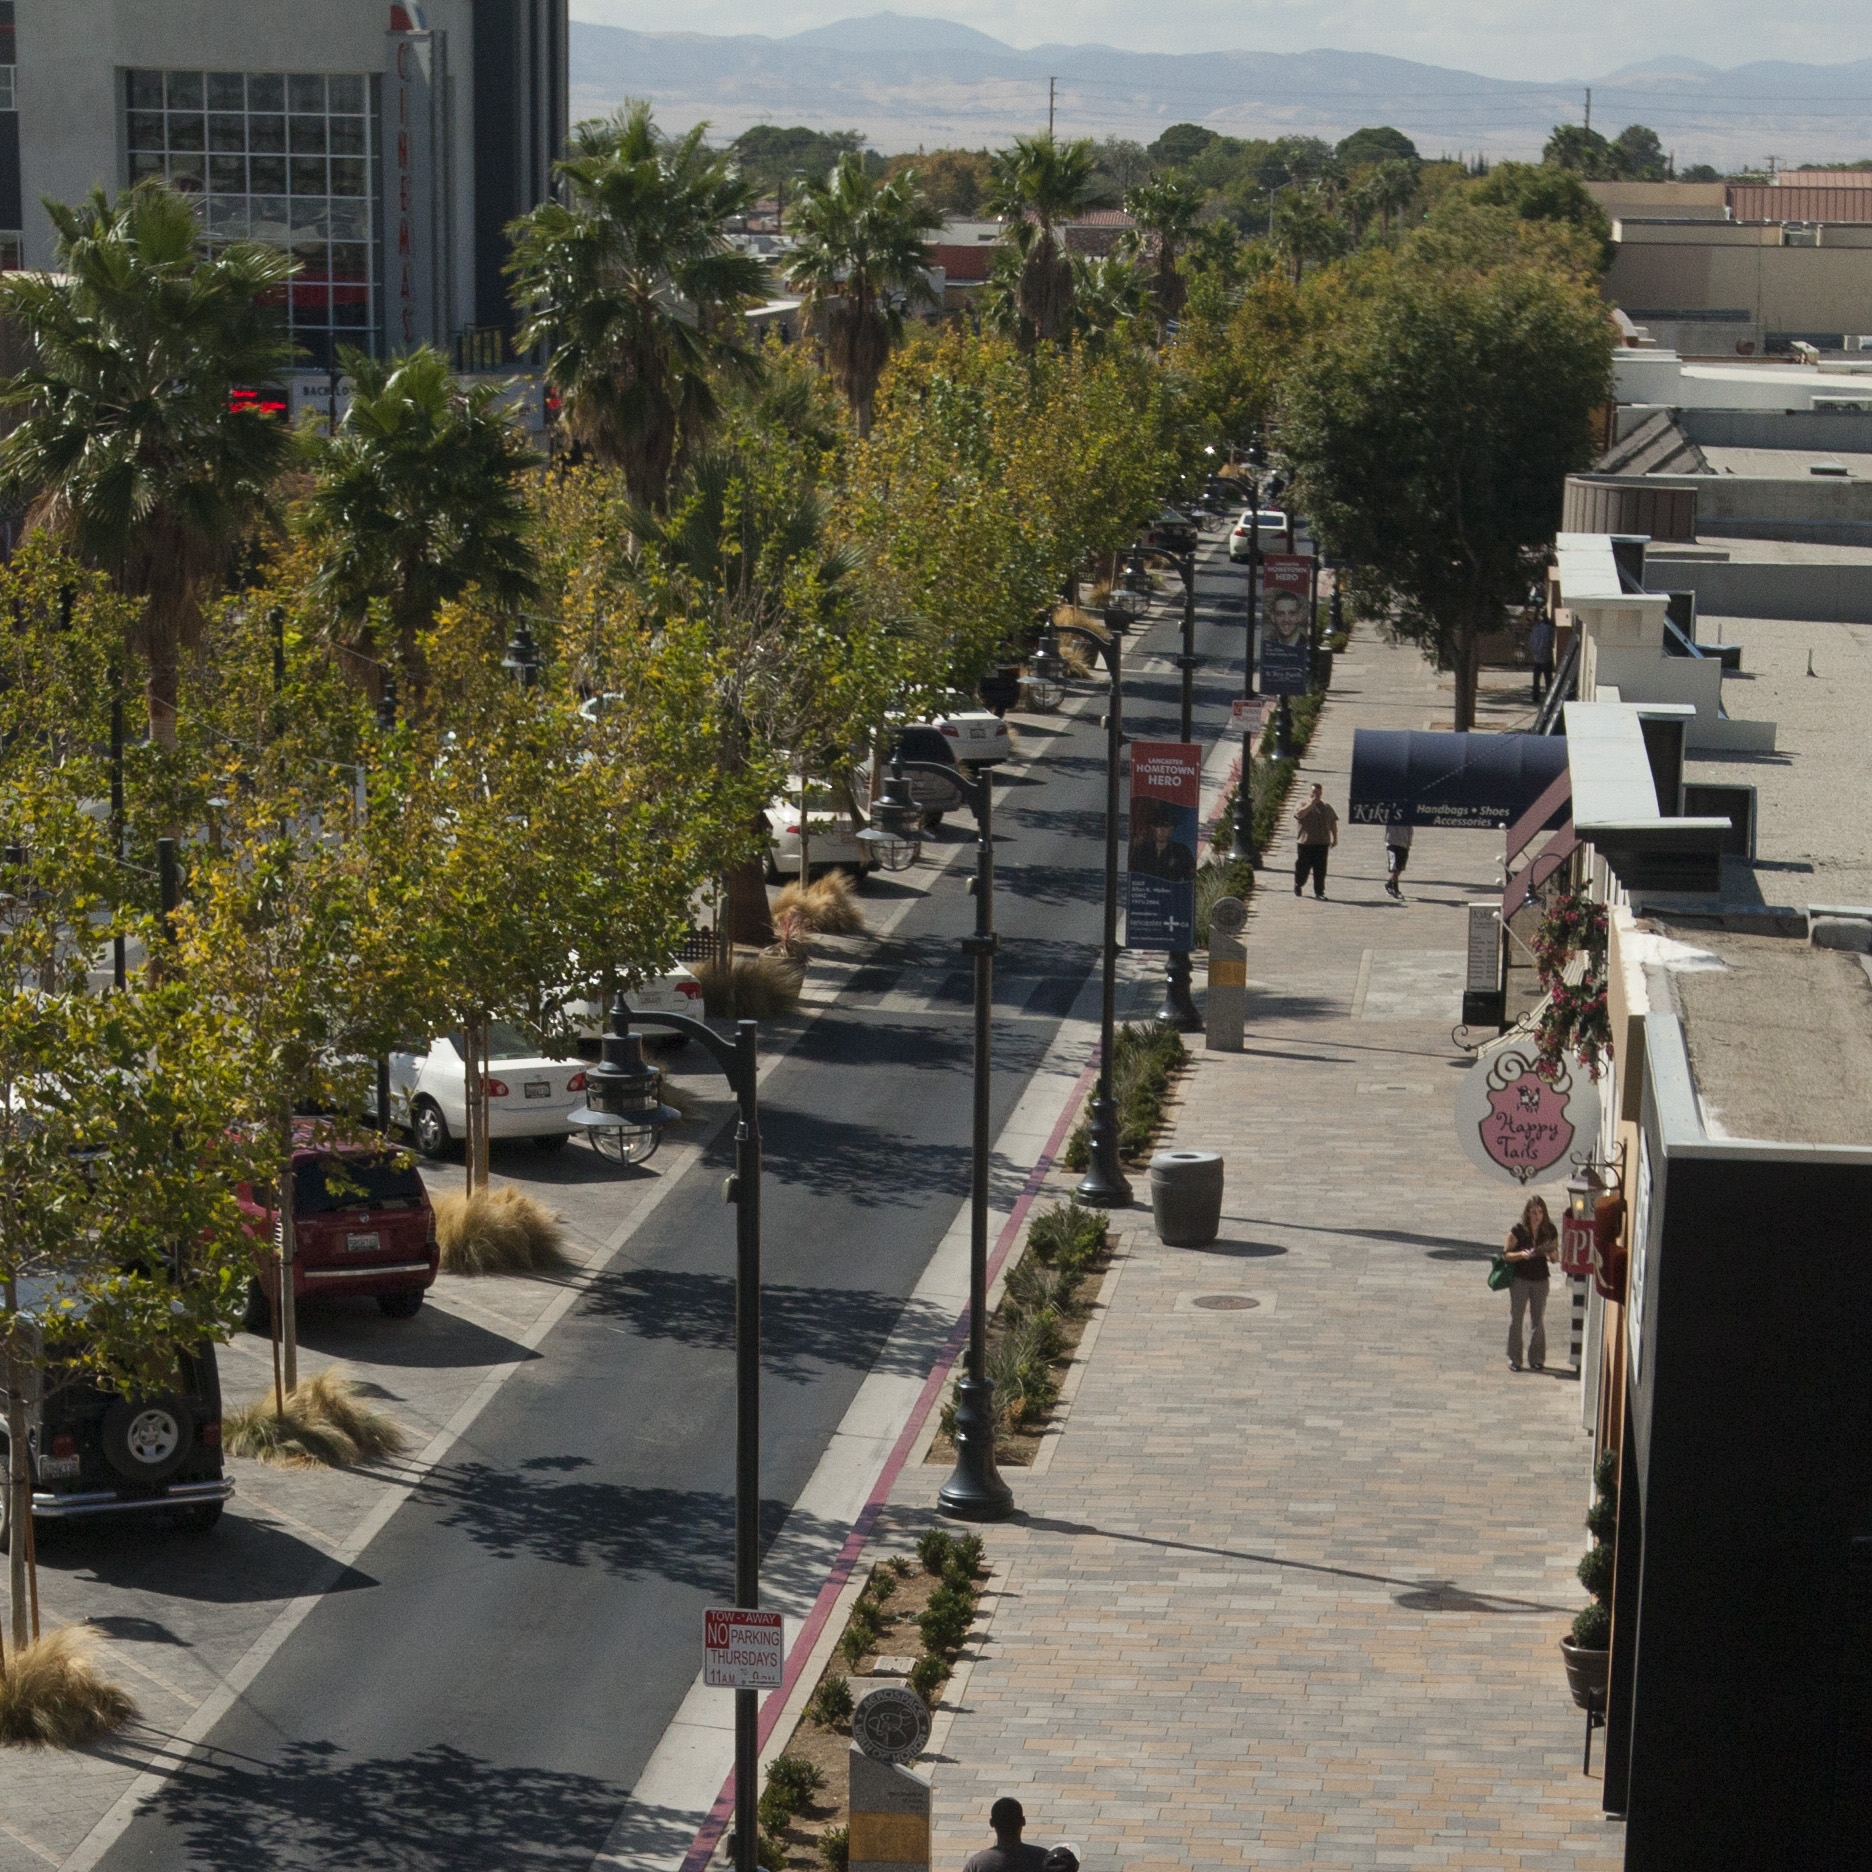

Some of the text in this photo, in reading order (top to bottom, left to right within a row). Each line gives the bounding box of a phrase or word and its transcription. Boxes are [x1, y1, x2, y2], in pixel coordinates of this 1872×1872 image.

[396, 42, 411, 343] CINEMAS
[1136, 764, 1195, 776] HOMETOWN
[1148, 775, 1182, 787] HERO
[1353, 802, 1404, 823] Kiki's
[1416, 804, 1511, 817] Handbags Shoes
[1433, 815, 1492, 827] Accessories
[1496, 1112, 1559, 1142] Happy
[1496, 1136, 1539, 1160] Tails
[710, 1610, 776, 1625] TOW AWAY
[708, 1622, 729, 1646] NO
[731, 1629, 780, 1647] PARKING
[710, 1649, 778, 1668] THURSDAYS
